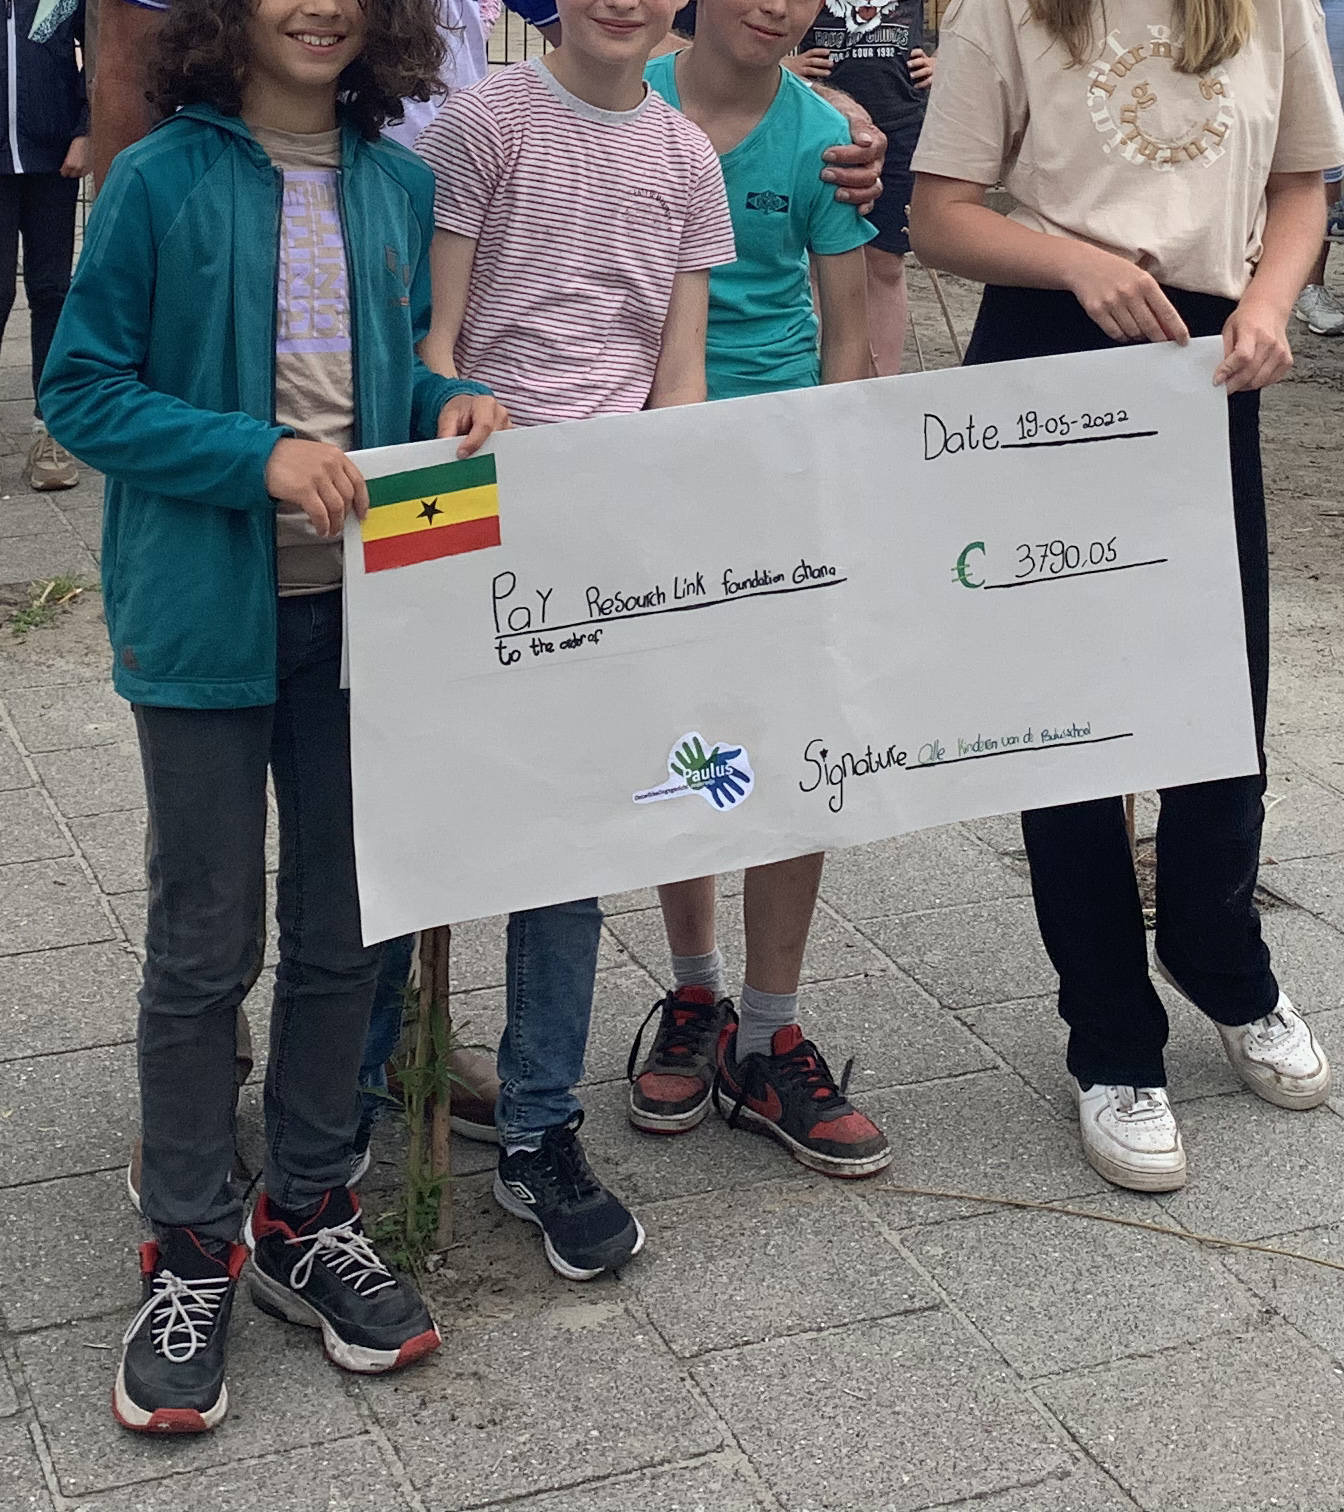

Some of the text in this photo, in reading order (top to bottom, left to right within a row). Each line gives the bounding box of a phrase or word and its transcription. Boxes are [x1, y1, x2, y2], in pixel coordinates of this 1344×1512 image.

[923, 410, 1129, 461] Date 19-05-2022
[1014, 536, 1118, 578] 3790,05
[673, 571, 706, 600] Link
[791, 558, 837, 584] Ghana
[494, 639, 522, 666] to
[528, 637, 555, 657] the
[587, 628, 603, 645] of
[682, 762, 734, 783] Paulus
[799, 738, 908, 813] Signature
